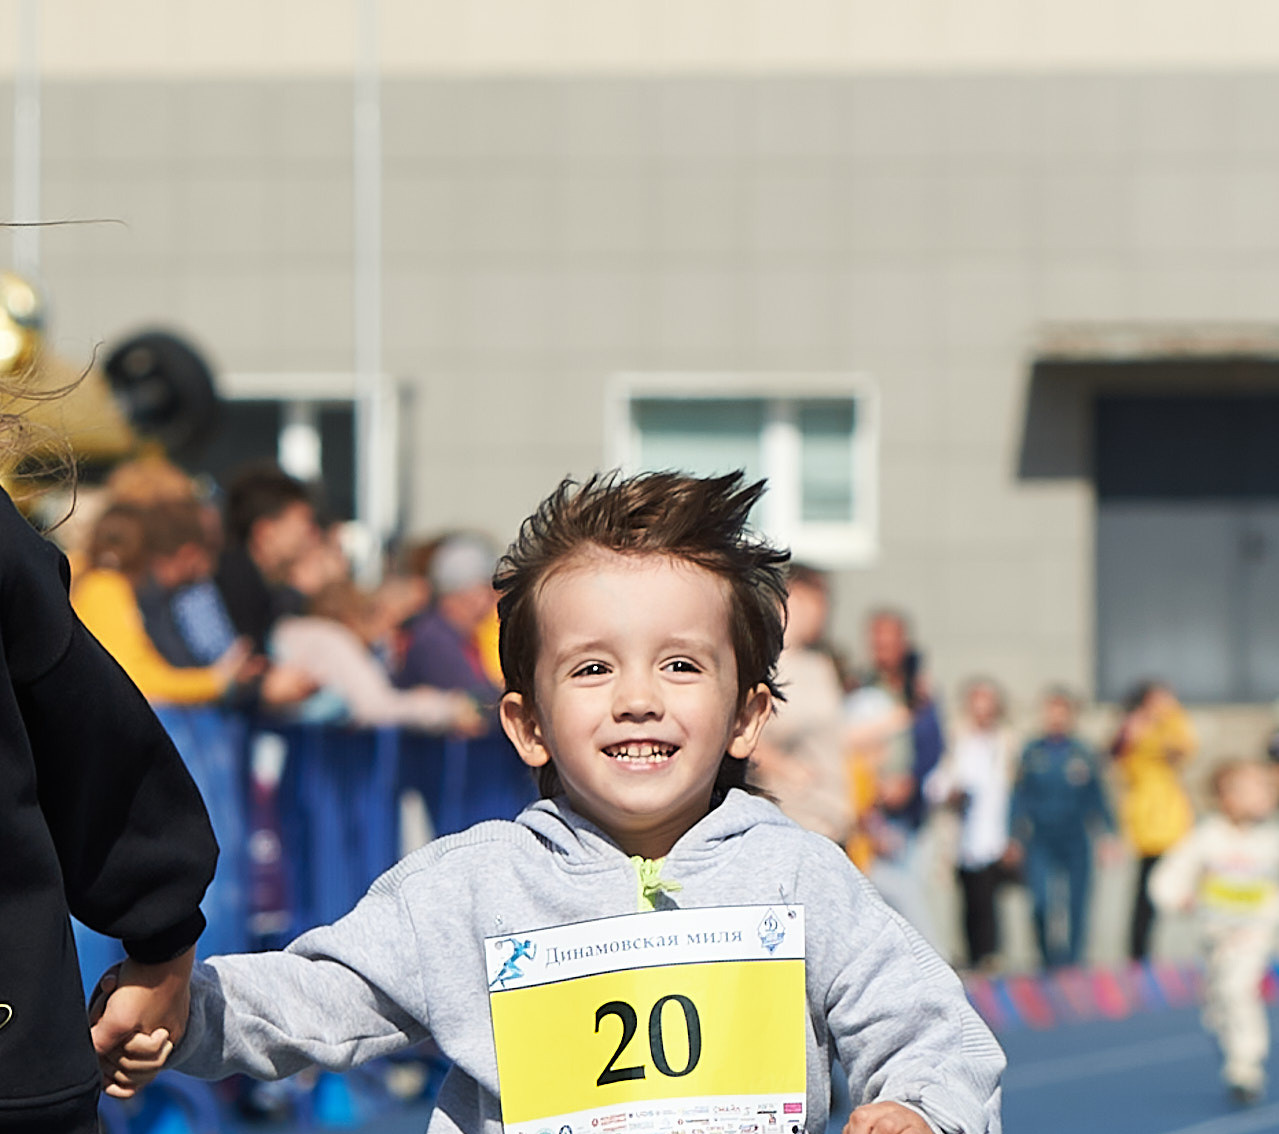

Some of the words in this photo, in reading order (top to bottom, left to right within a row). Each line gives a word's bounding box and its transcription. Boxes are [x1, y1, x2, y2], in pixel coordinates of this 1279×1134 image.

[544, 935, 680, 967] Динамовская
[686, 930, 743, 945] миля
[594, 994, 702, 1087] 20
